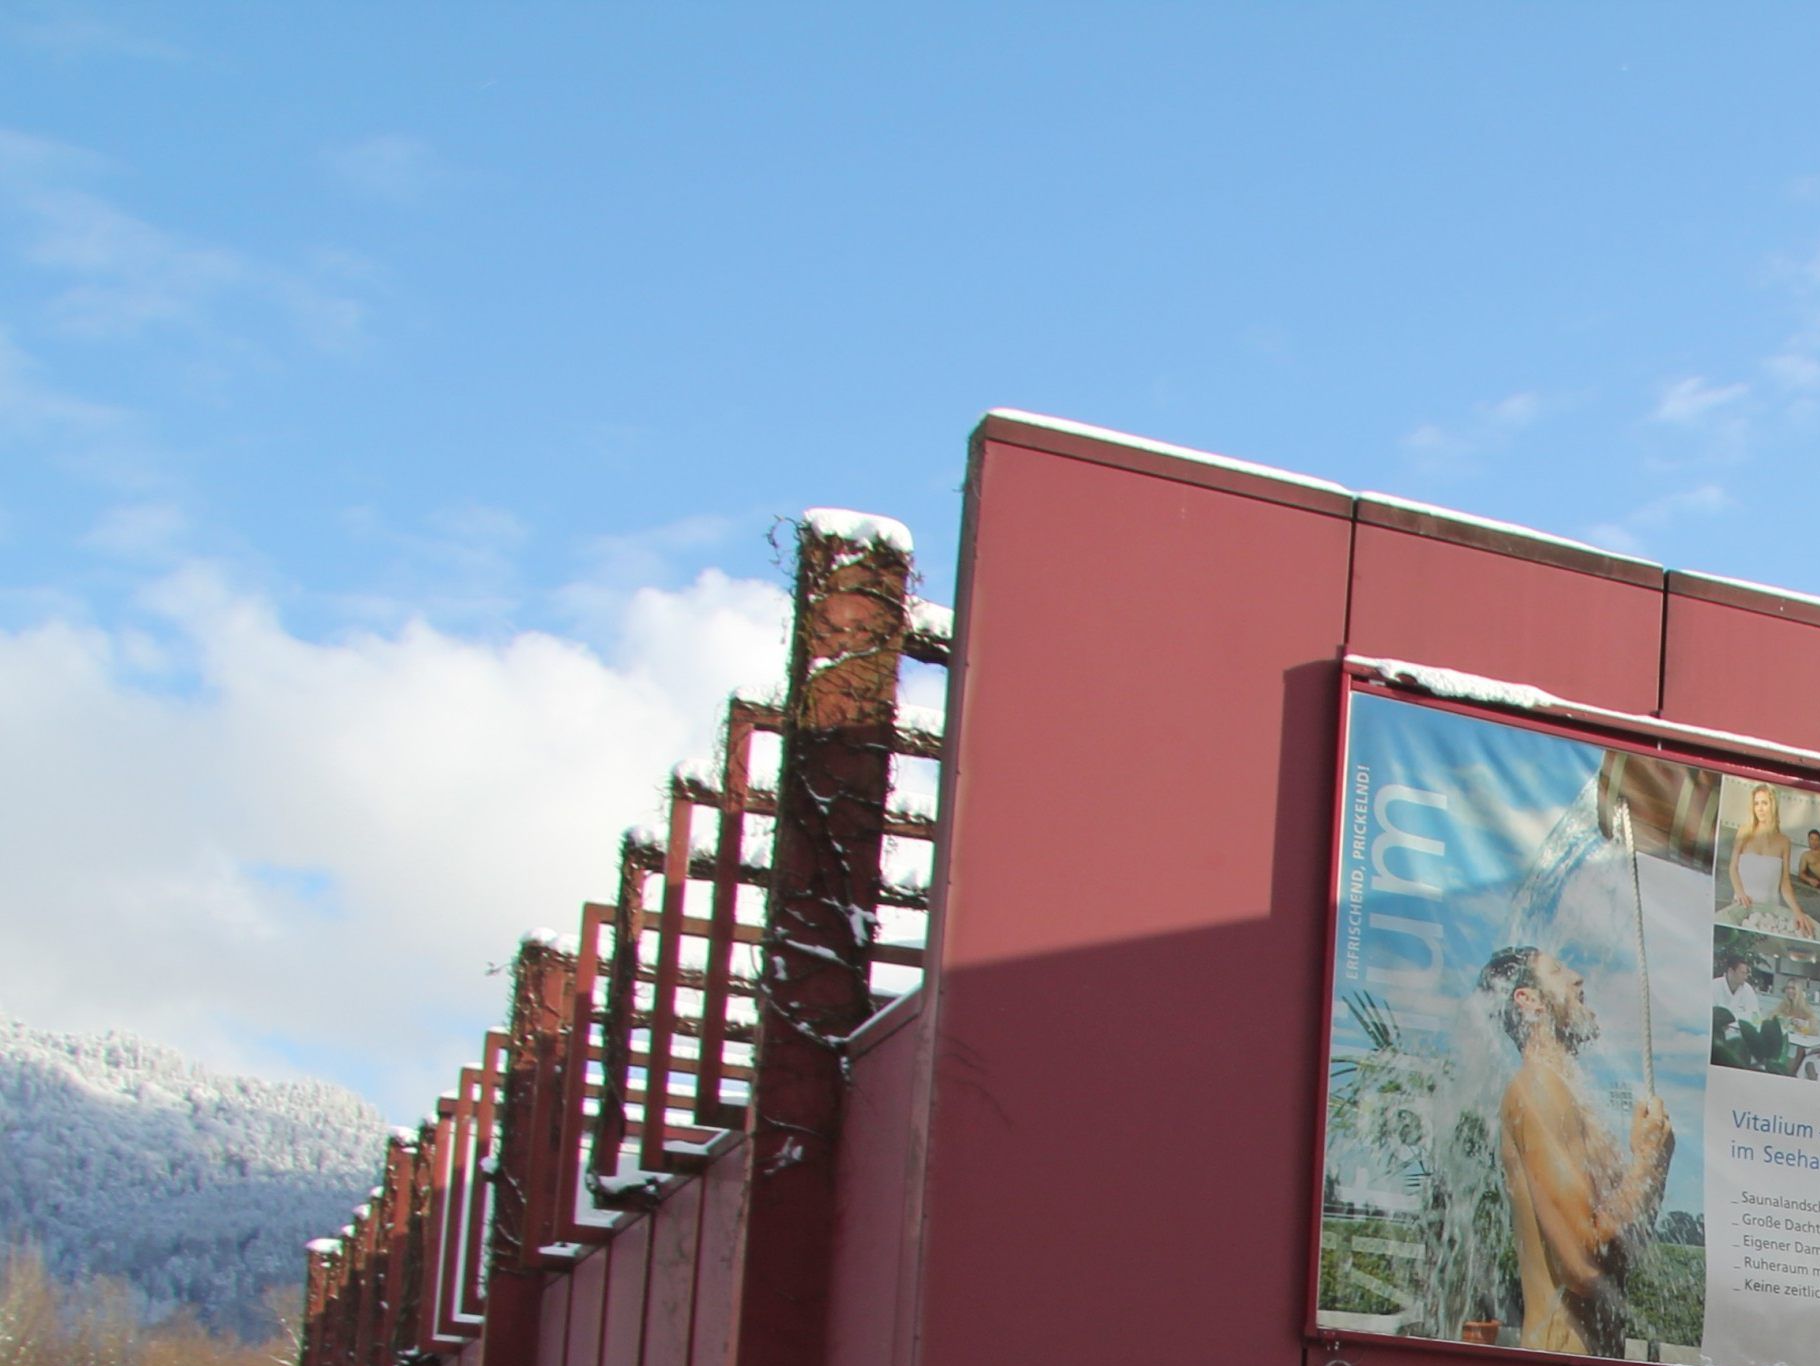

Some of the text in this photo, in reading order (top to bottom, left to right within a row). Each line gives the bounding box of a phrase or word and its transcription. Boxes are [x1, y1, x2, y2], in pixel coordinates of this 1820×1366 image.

[1345, 764, 1370, 981] ERFRISCHEND, PRICKELND!
[1731, 1109, 1814, 1139] Vitalium
[1730, 1140, 1755, 1161] im
[1742, 1212, 1782, 1230] Große
[1743, 1234, 1792, 1253] Eigener
[1744, 1256, 1809, 1276] Ruheraum
[1744, 1278, 1781, 1295] Keine
